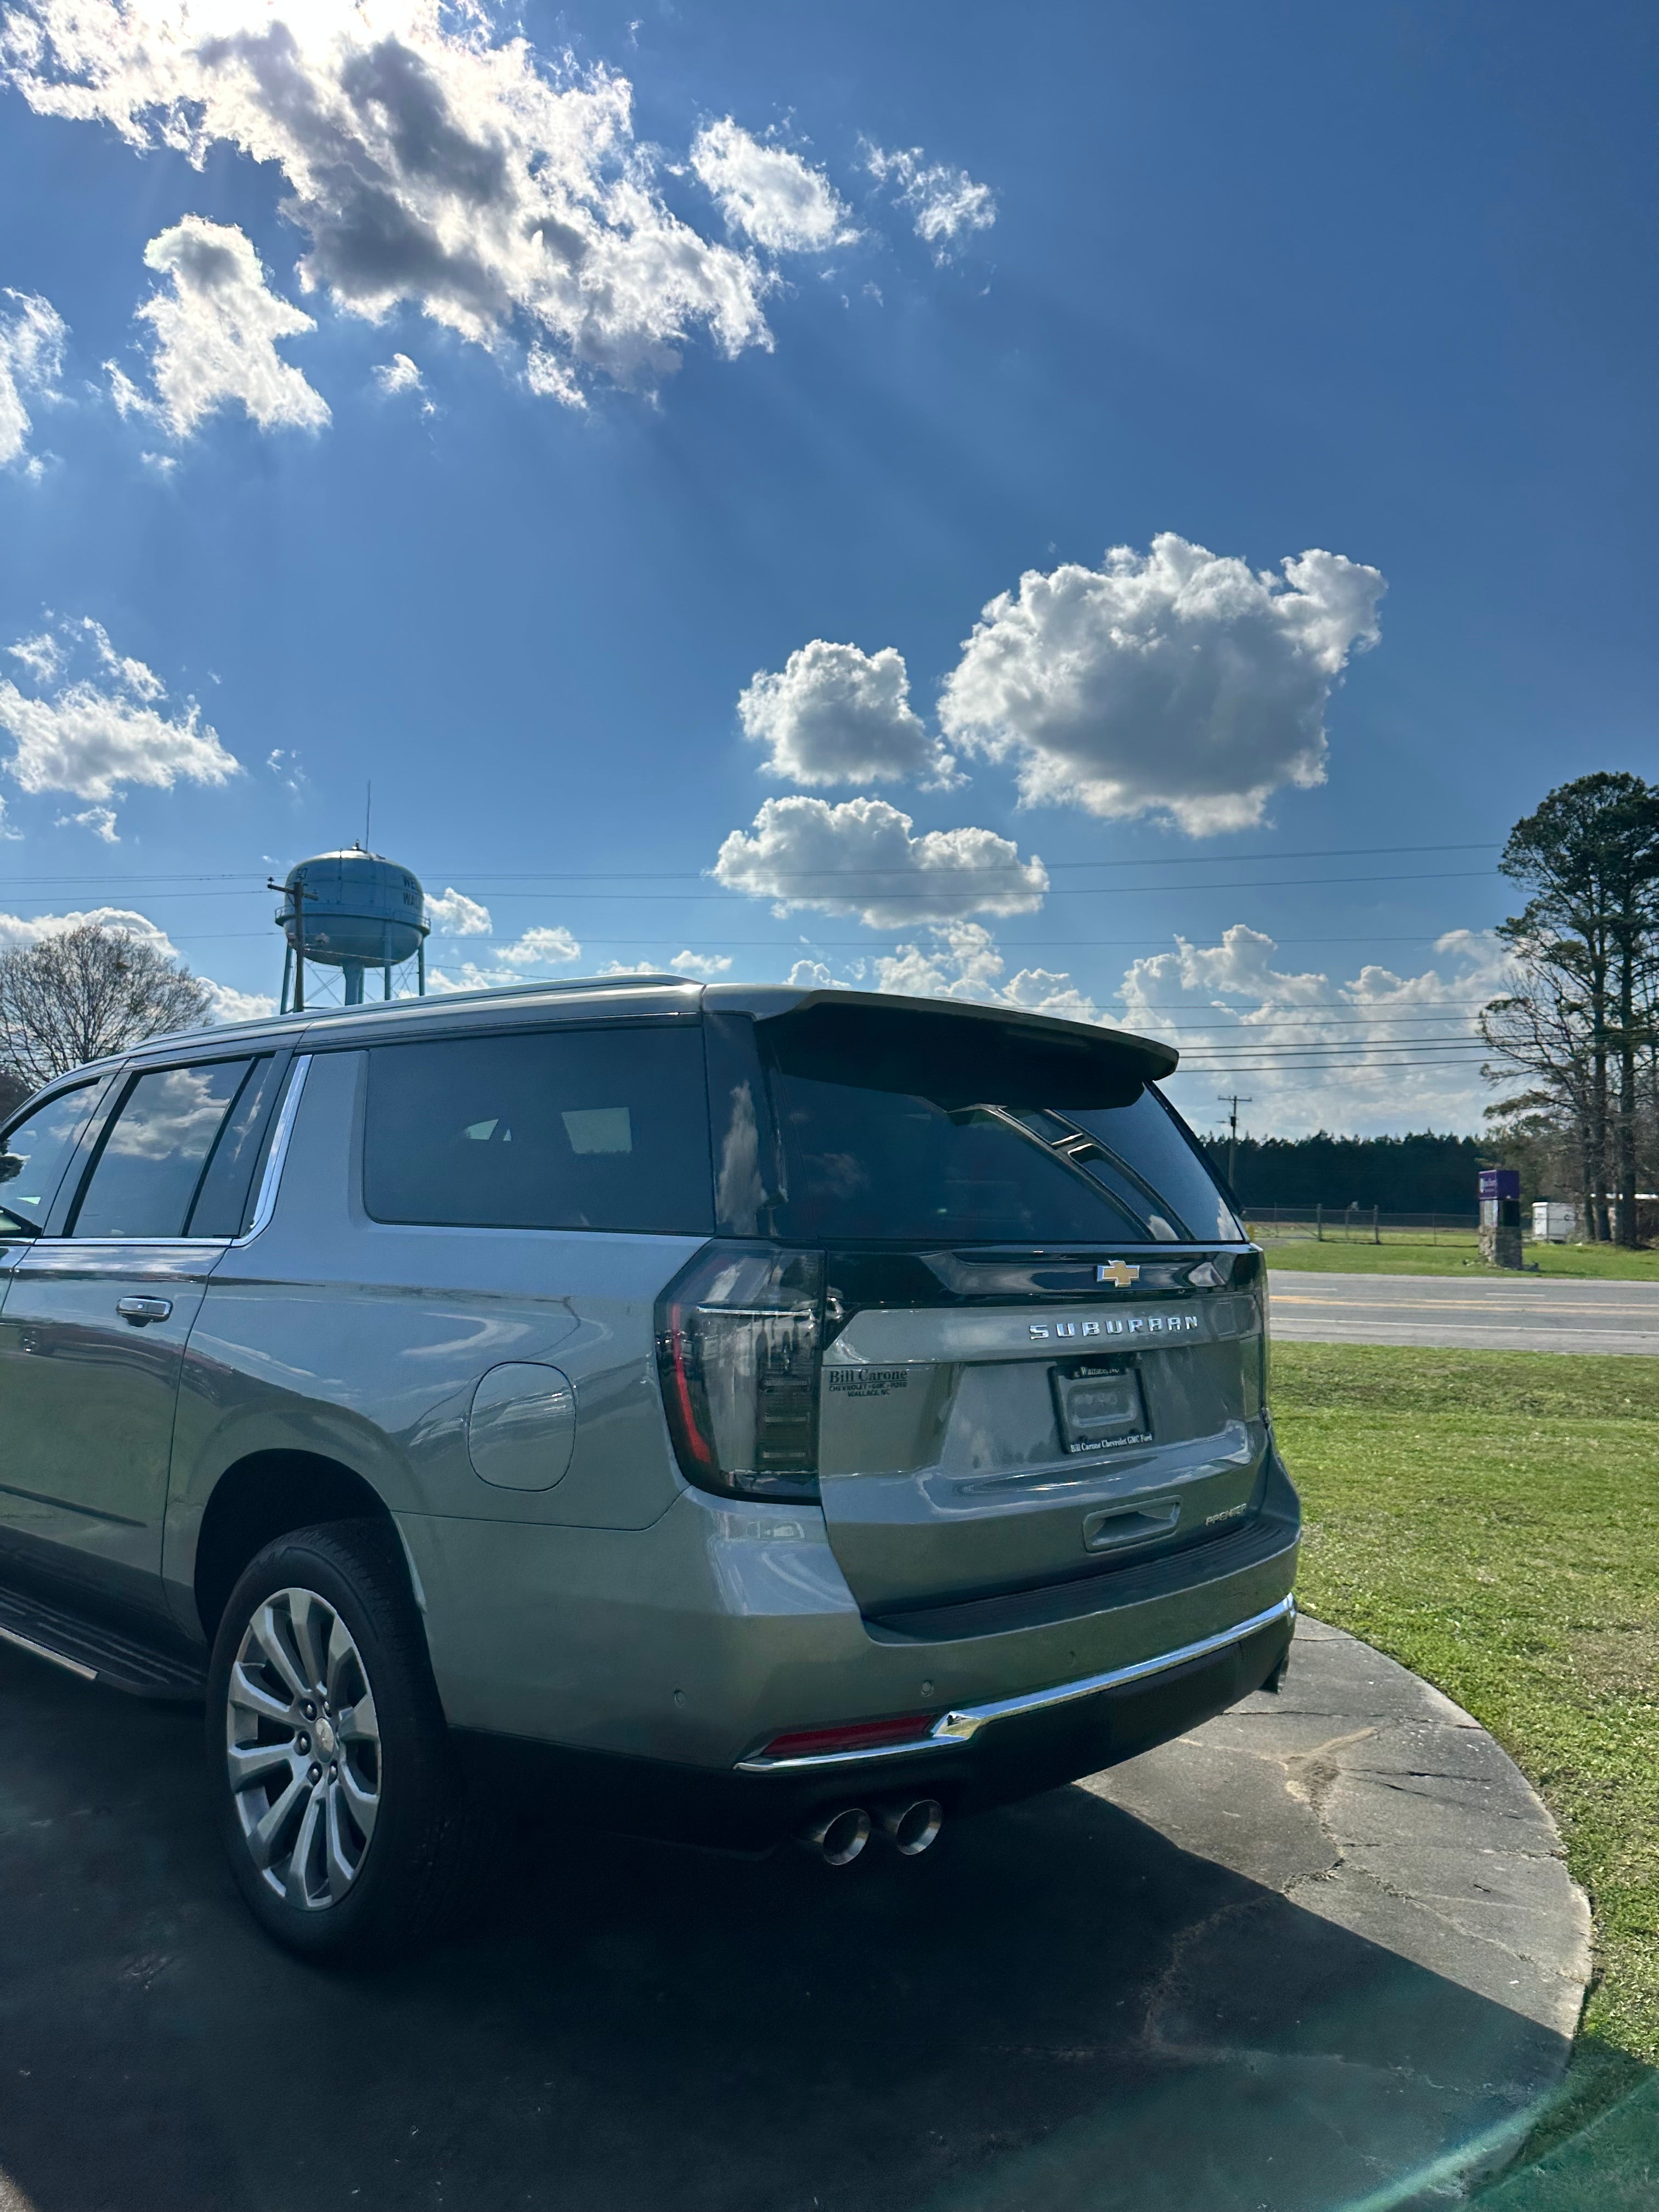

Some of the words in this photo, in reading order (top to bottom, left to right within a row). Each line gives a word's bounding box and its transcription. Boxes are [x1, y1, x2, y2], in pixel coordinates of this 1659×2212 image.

[1029, 1316, 1198, 1340] SUBURBAN
[829, 1370, 854, 1383] Bill
[859, 1369, 908, 1381] Carone
[1070, 1443, 1081, 1452] Bill
[1081, 1442, 1102, 1451] Carone
[1102, 1437, 1127, 1448] Chevrolet
[1127, 1435, 1139, 1444] GMC
[1140, 1434, 1153, 1442] Ford
